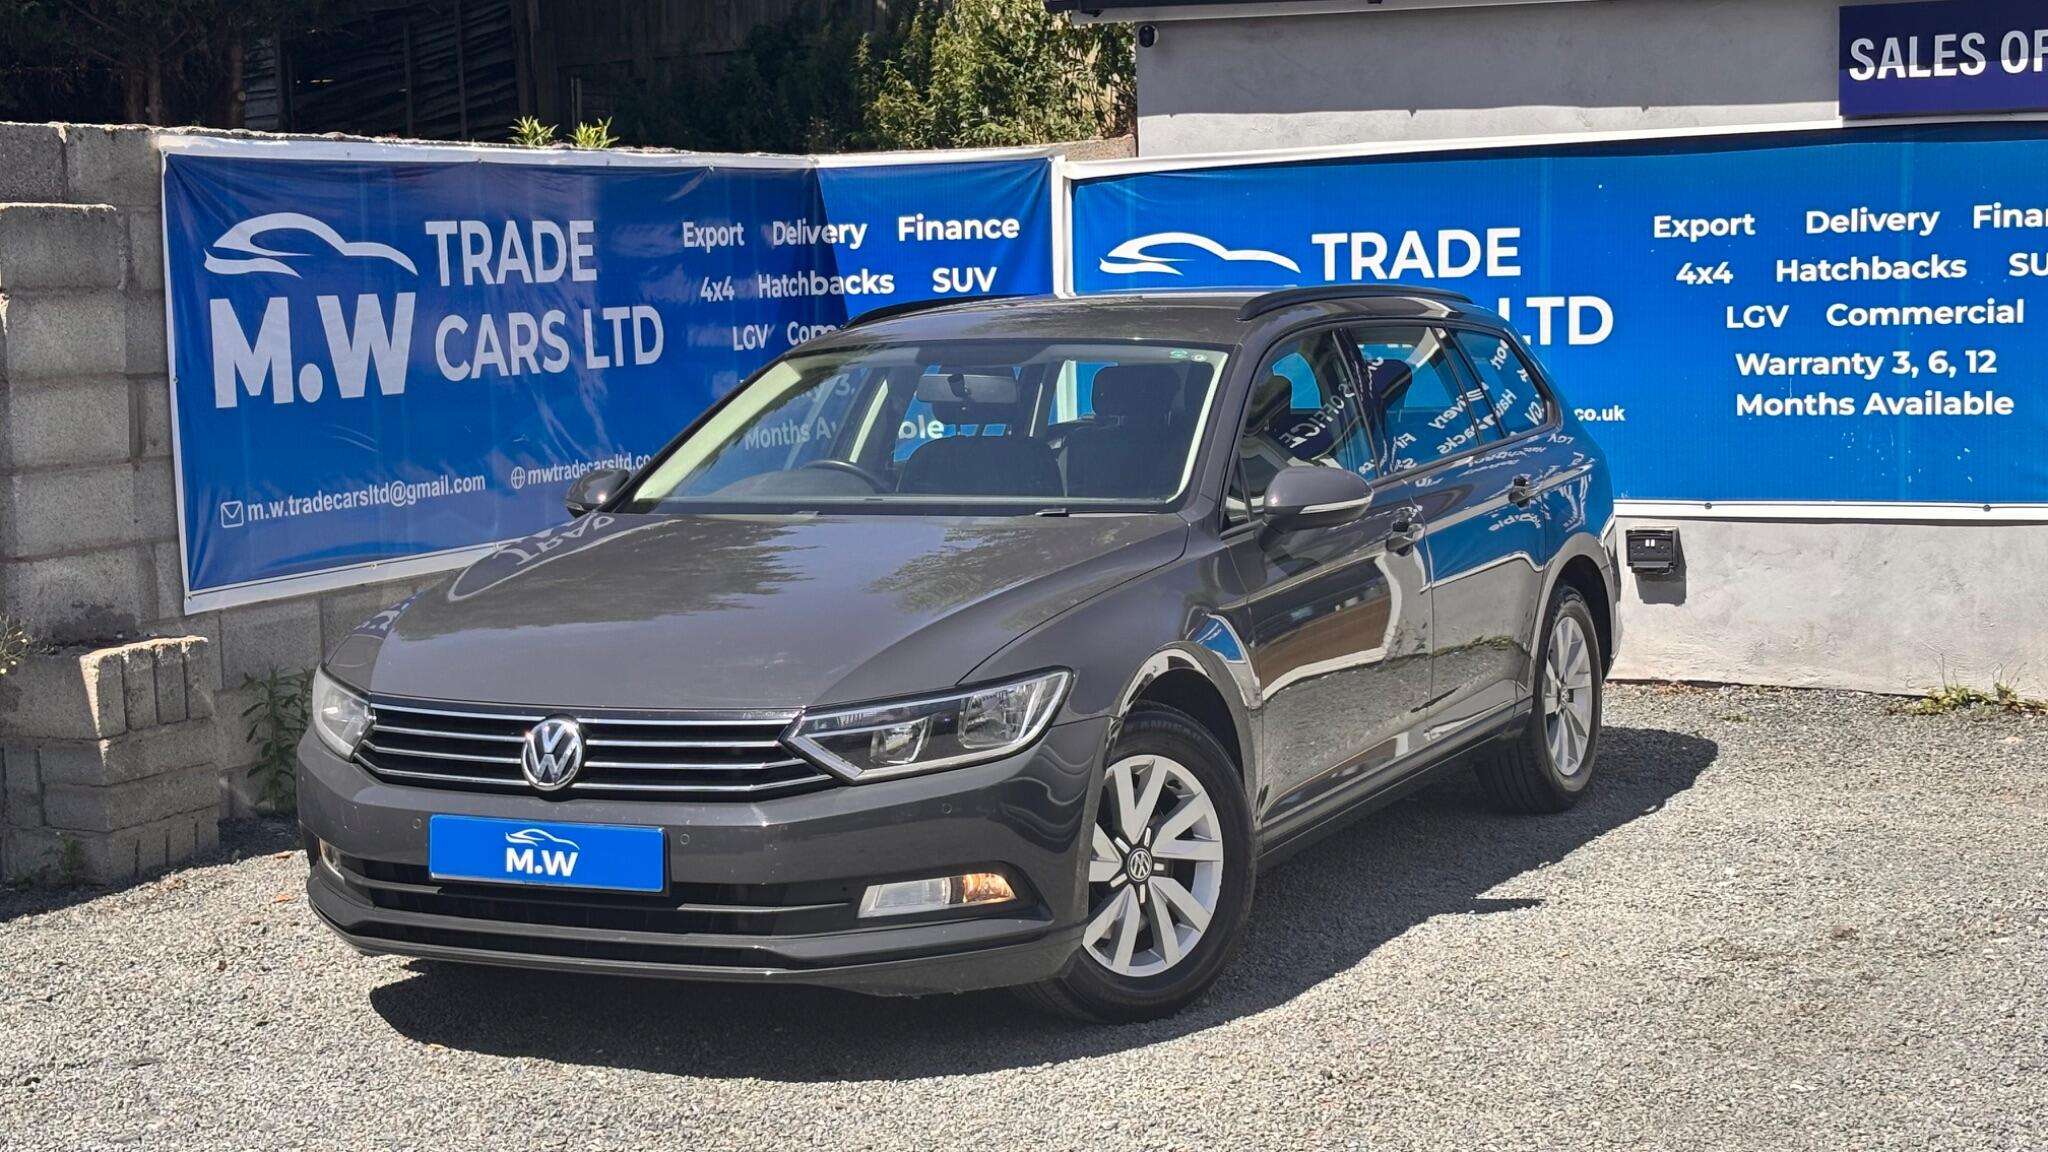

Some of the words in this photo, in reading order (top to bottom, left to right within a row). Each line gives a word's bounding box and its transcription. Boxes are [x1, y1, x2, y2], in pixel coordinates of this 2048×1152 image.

[1850, 33, 1986, 80] SALES
[2001, 29, 2048, 74] OF
[683, 221, 745, 252] Export
[773, 217, 867, 250] Delivery
[898, 212, 1020, 242] Finance
[1653, 213, 1755, 242] Export
[1806, 206, 1940, 236] Delivery
[1973, 202, 2048, 229] Fina
[425, 219, 598, 287] TRADE
[1311, 227, 1521, 281] TRADE
[1675, 261, 1734, 285] 4x4
[1776, 253, 1967, 282] Hatchbacks
[700, 275, 736, 302] 4x4
[758, 268, 895, 298] Hatchbacks
[932, 266, 997, 293] SUV
[1726, 304, 1789, 329] LGV
[1826, 298, 2024, 327] Commercial
[209, 292, 416, 409] M.W
[435, 310, 570, 382] CARS
[583, 305, 664, 370] LTD
[732, 324, 769, 351] LGV
[1735, 353, 1884, 380] Warranty
[1892, 350, 1919, 379] 3,
[1928, 350, 1957, 378] 6,
[1965, 350, 1997, 374] 12
[1574, 404, 1626, 422] co.uk
[1736, 392, 1856, 416] Months
[1863, 389, 2015, 416] Available
[744, 418, 811, 450] Months
[247, 473, 486, 522] m.w.tradecarsltd@gmail.com
[506, 847, 578, 877] M.W
